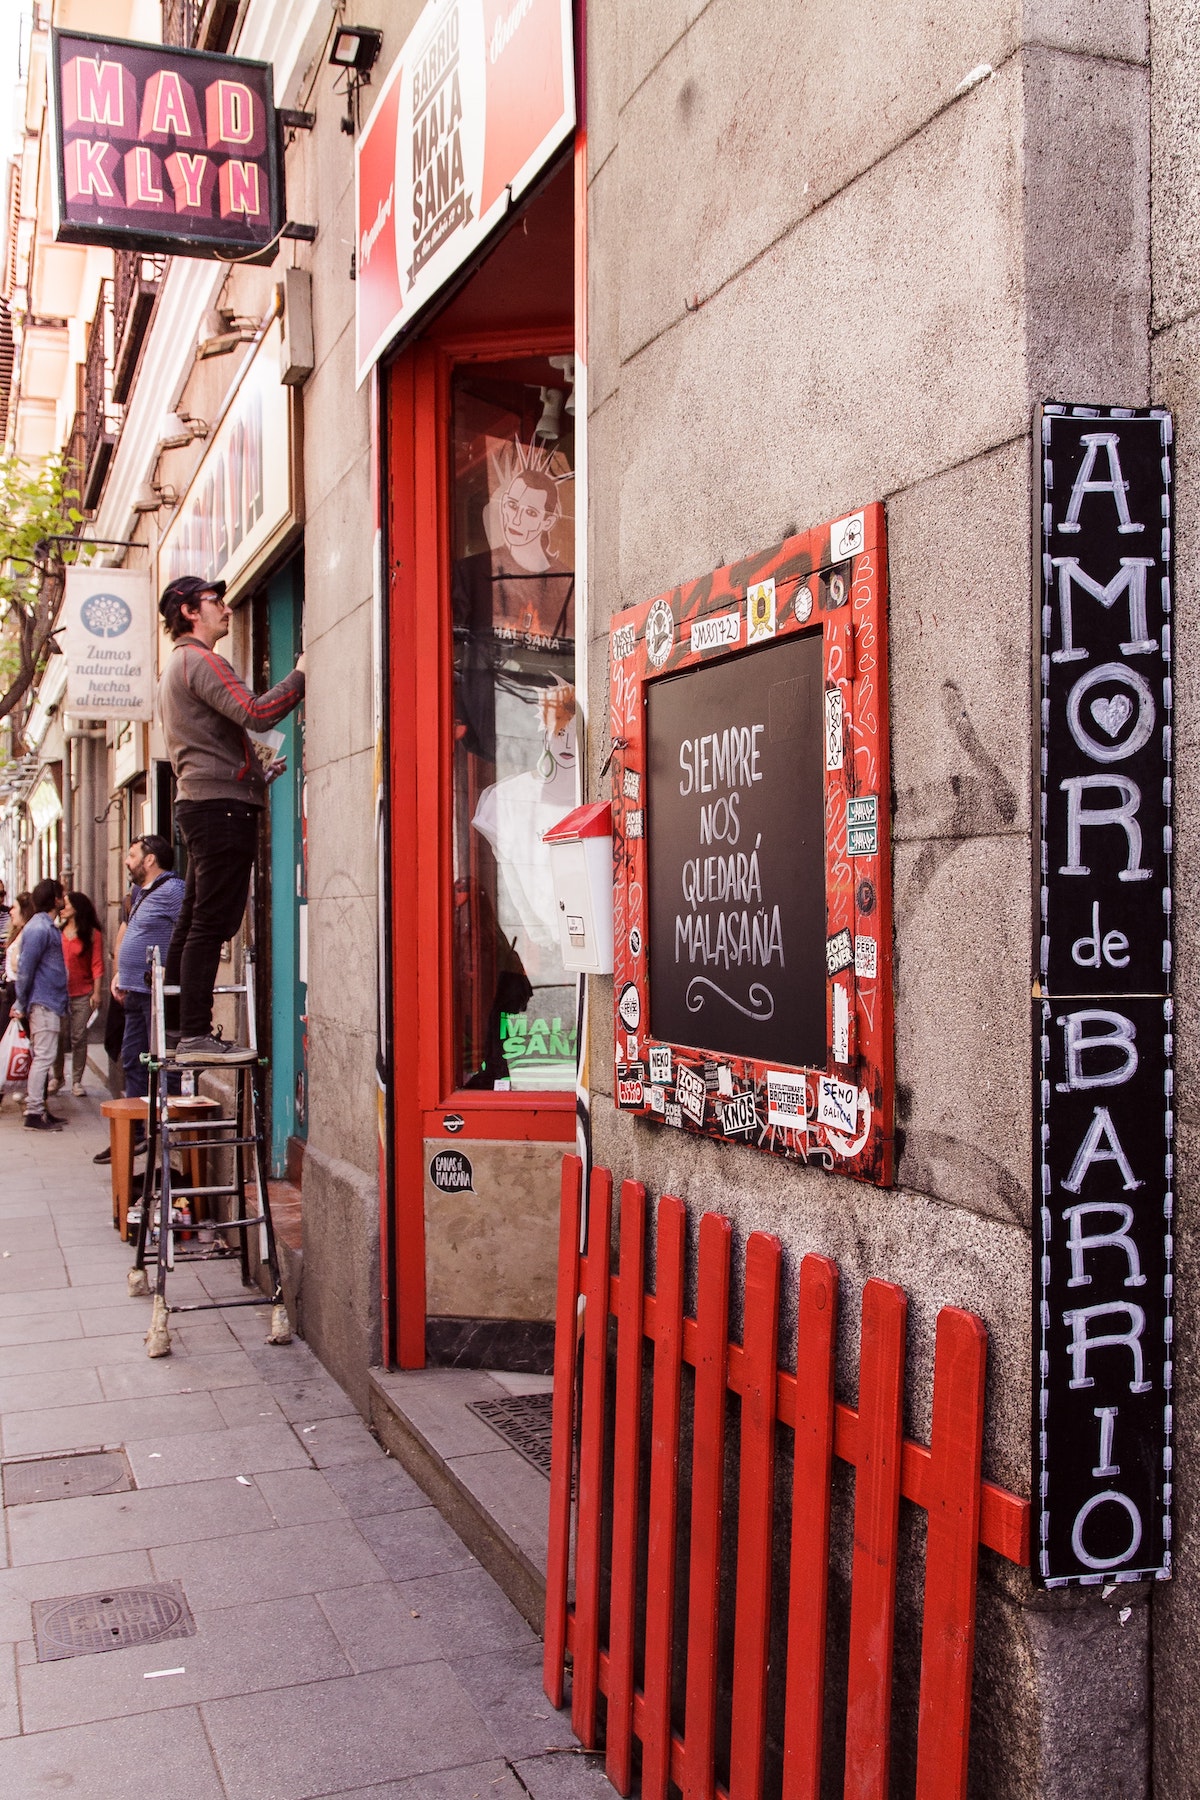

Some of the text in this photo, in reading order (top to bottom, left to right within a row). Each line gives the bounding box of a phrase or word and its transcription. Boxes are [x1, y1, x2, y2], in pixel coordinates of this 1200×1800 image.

[412, 5, 459, 114] BARRIO
[64, 56, 266, 150] MAD
[64, 139, 269, 220] KLYN
[86, 644, 132, 661] Zumos
[75, 663, 143, 677] naturales
[88, 679, 131, 693] hechos
[75, 694, 144, 708] al instante
[679, 724, 765, 797] SIEMPRE
[699, 791, 740, 846] NOS
[682, 832, 762, 912] QUEDARÁ
[675, 904, 785, 971] MALASAÑA
[856, 942, 876, 954] PERO
[1051, 432, 1160, 1569] AMOR de BARRIO
[651, 1052, 670, 1068] NEKO
[769, 1082, 805, 1094] REVOLUTIONARY
[769, 1090, 805, 1105] BROTHERS
[723, 1096, 754, 1130] KNOS
[777, 1101, 798, 1115] MUSIC
[435, 1170, 471, 1187] MALASAÑA
